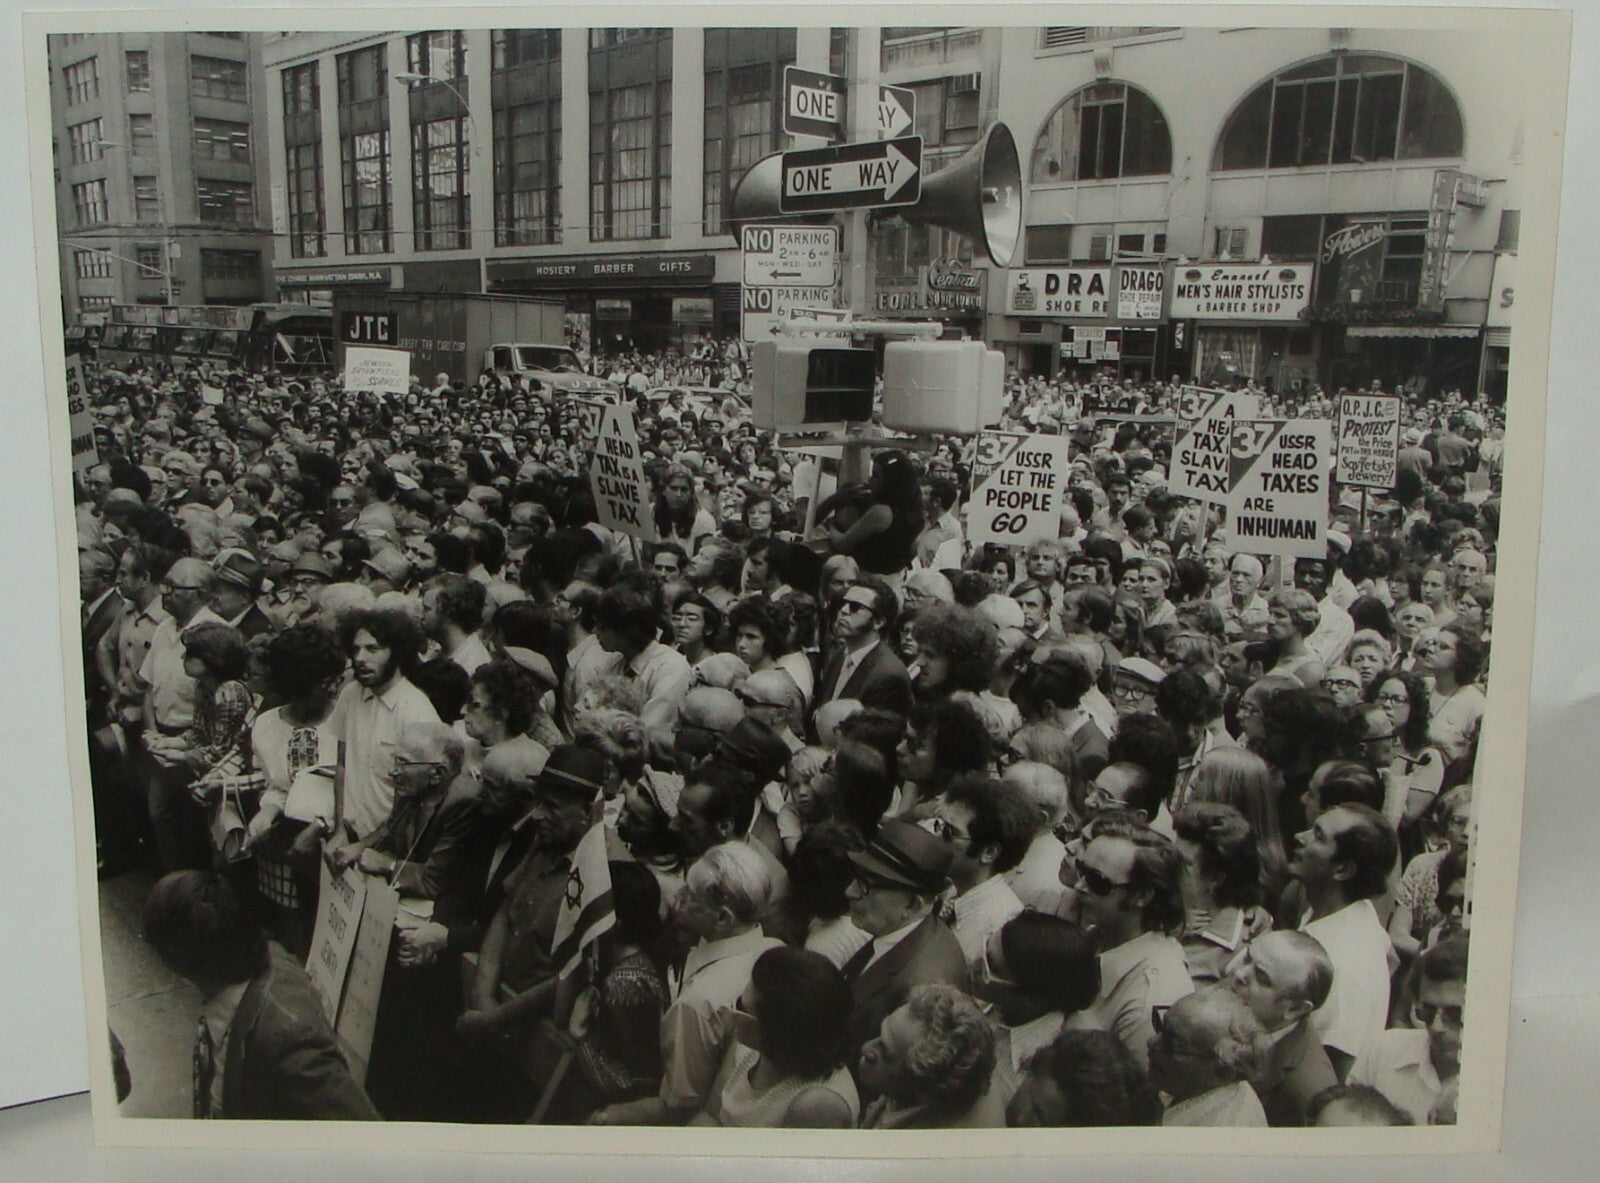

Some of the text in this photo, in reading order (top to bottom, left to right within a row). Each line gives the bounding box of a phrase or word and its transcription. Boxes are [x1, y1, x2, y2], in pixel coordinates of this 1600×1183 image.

[796, 90, 835, 119] ONE
[792, 160, 899, 192] ONE WAY
[745, 229, 830, 251] NO PARKING
[779, 247, 788, 259] 2
[808, 247, 816, 259] 6
[537, 262, 692, 275] HOSIERY BARBER GIFTS
[1211, 269, 1270, 281] Emanuel
[1045, 273, 1105, 295] DRA
[1121, 270, 1164, 292] DRAGO
[1177, 284, 1304, 299] MEN'S HAIR STYLISTS
[744, 289, 829, 309] NO PARKING
[1046, 301, 1081, 312] SHOE
[1206, 302, 1246, 312] BARBER
[1252, 303, 1281, 313] SHOP
[350, 316, 389, 341] JTC
[1180, 393, 1215, 420] 37
[1224, 404, 1235, 418] A
[579, 406, 601, 440] 37
[613, 418, 621, 436] A
[1342, 419, 1396, 438] PROTEST
[604, 436, 633, 459] HEAD
[977, 436, 1018, 465] 37
[1193, 432, 1225, 454] TAX
[1231, 423, 1274, 459] 37
[1279, 434, 1316, 450] USSR
[1358, 437, 1393, 449] the Price
[596, 454, 639, 483] TAX IS A
[1016, 451, 1053, 469] USSR
[1180, 450, 1228, 472] SLAV
[1272, 453, 1317, 470] HEAD
[597, 476, 640, 504] SLAVE
[1000, 470, 1024, 486] LET
[1030, 472, 1056, 489] THE
[1185, 470, 1228, 494] TAX
[1260, 472, 1319, 493] TAXES
[986, 489, 1052, 512] PEOPLE
[1244, 497, 1274, 512] ARE
[608, 500, 641, 527] TAX
[991, 512, 1027, 534] GO
[1237, 516, 1316, 540] INHUMAN
